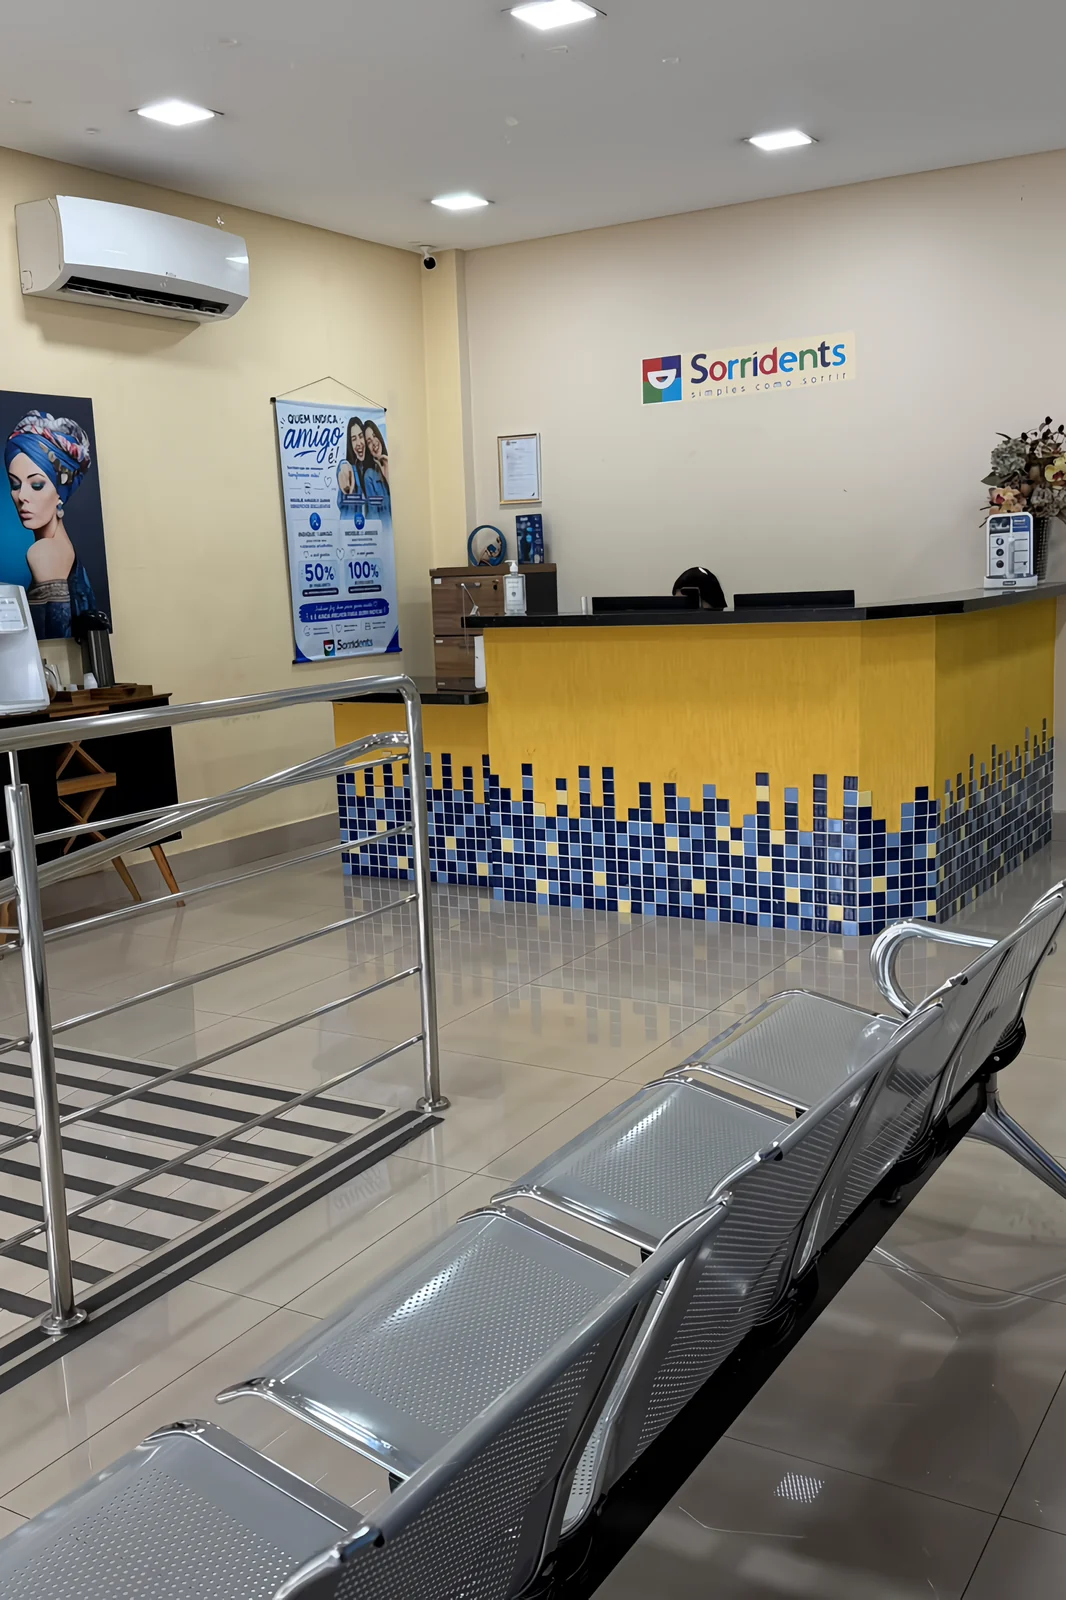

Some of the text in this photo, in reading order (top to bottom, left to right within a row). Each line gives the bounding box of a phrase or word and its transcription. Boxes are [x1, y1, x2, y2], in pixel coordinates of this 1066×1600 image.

[690, 341, 846, 384] Sorridents
[691, 372, 847, 398] simples como sorrir
[287, 413, 311, 425] QUEM
[283, 425, 344, 464] amigo
[305, 563, 335, 582] 50%
[348, 561, 379, 580] 100%
